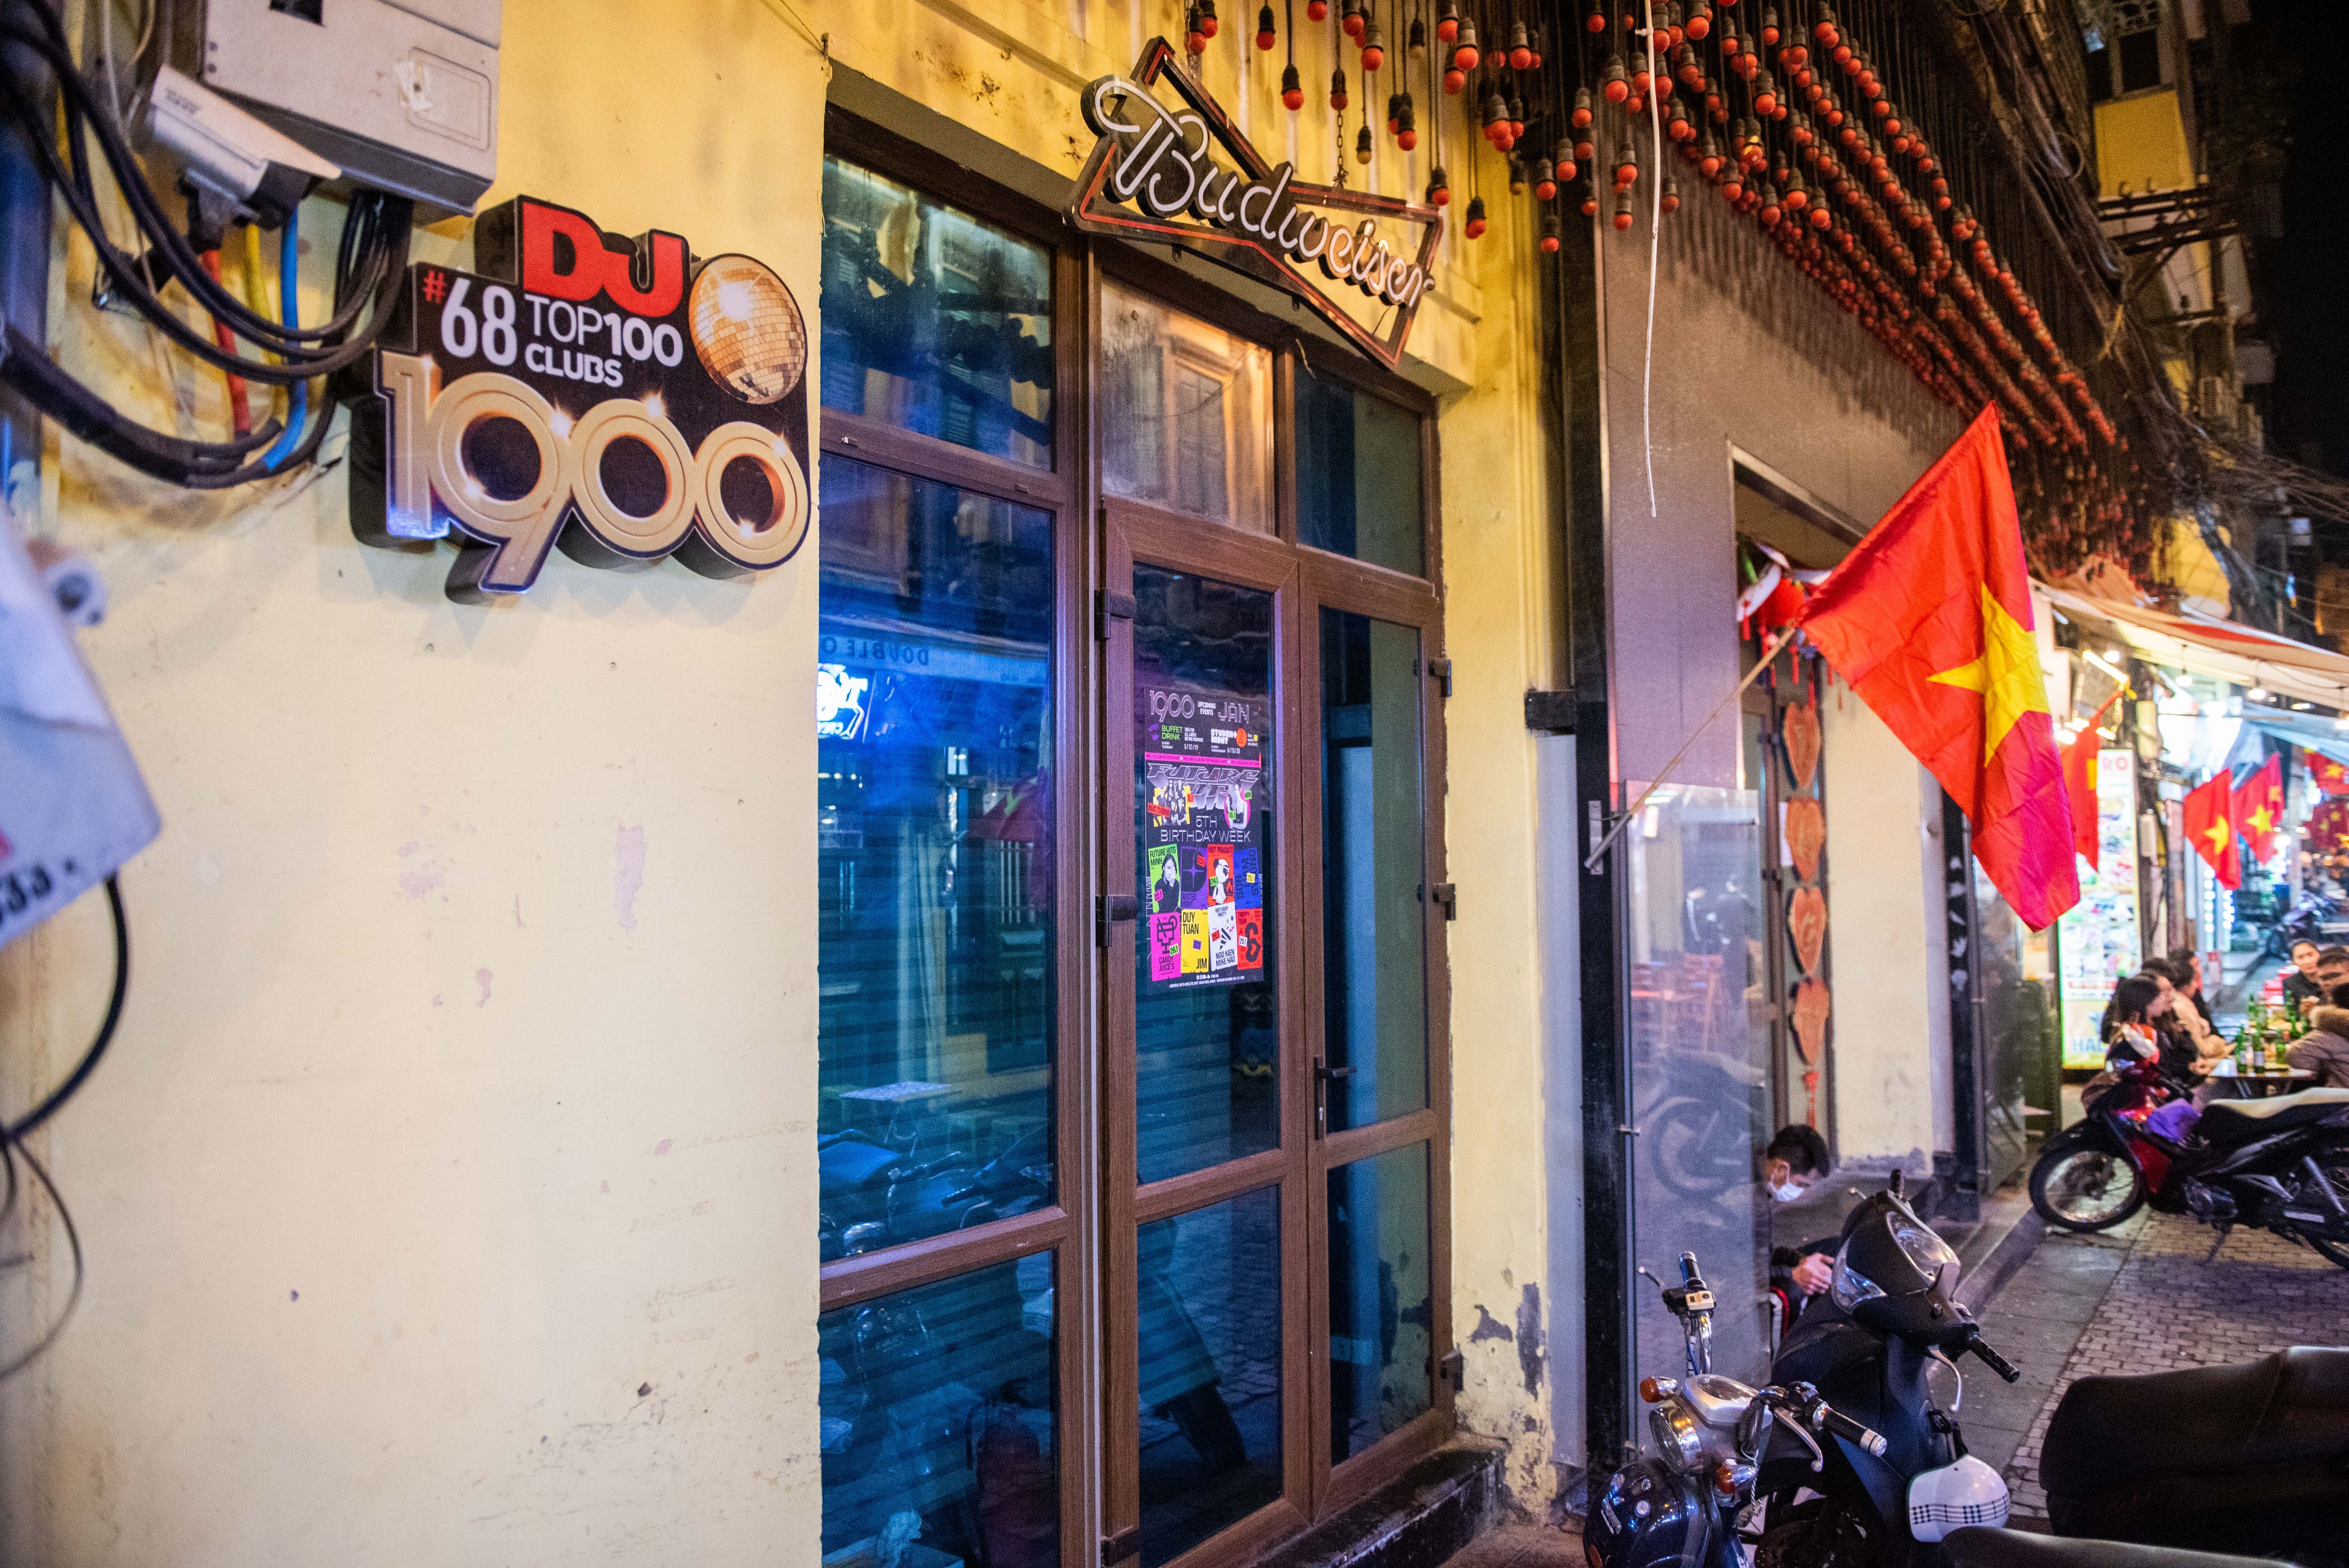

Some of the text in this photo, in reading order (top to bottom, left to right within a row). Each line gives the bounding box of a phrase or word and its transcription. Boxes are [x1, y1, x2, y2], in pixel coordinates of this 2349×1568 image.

[1094, 79, 1434, 307] Budweiser
[522, 201, 684, 317] DJ
[423, 270, 518, 366] #68
[524, 345, 624, 388] CLUBS
[381, 349, 810, 593] 1900
[1150, 690, 1195, 722] 1900
[1218, 702, 1249, 724] JAN
[1162, 725, 1183, 733] BUFFET
[1211, 736, 1229, 745] NIGHT
[1146, 763, 1260, 783] FUTURE
[1196, 815, 1217, 827] 5TH
[1160, 830, 1251, 842] BIRTHDAY WEEK
[1150, 848, 1166, 858] FUTURE
[1150, 857, 1162, 866] MINH
[1235, 875, 1244, 900] BOB
[1155, 891, 1163, 901] 22.1
[1181, 900, 1193, 908] NIGHT
[1183, 912, 1195, 923] DUY
[1183, 924, 1199, 934] TUAN
[1215, 948, 1235, 959] NGO KIEN
[1159, 955, 1173, 964] CANDY
[1196, 958, 1207, 969] JIM
[1215, 959, 1226, 967] MIKE
